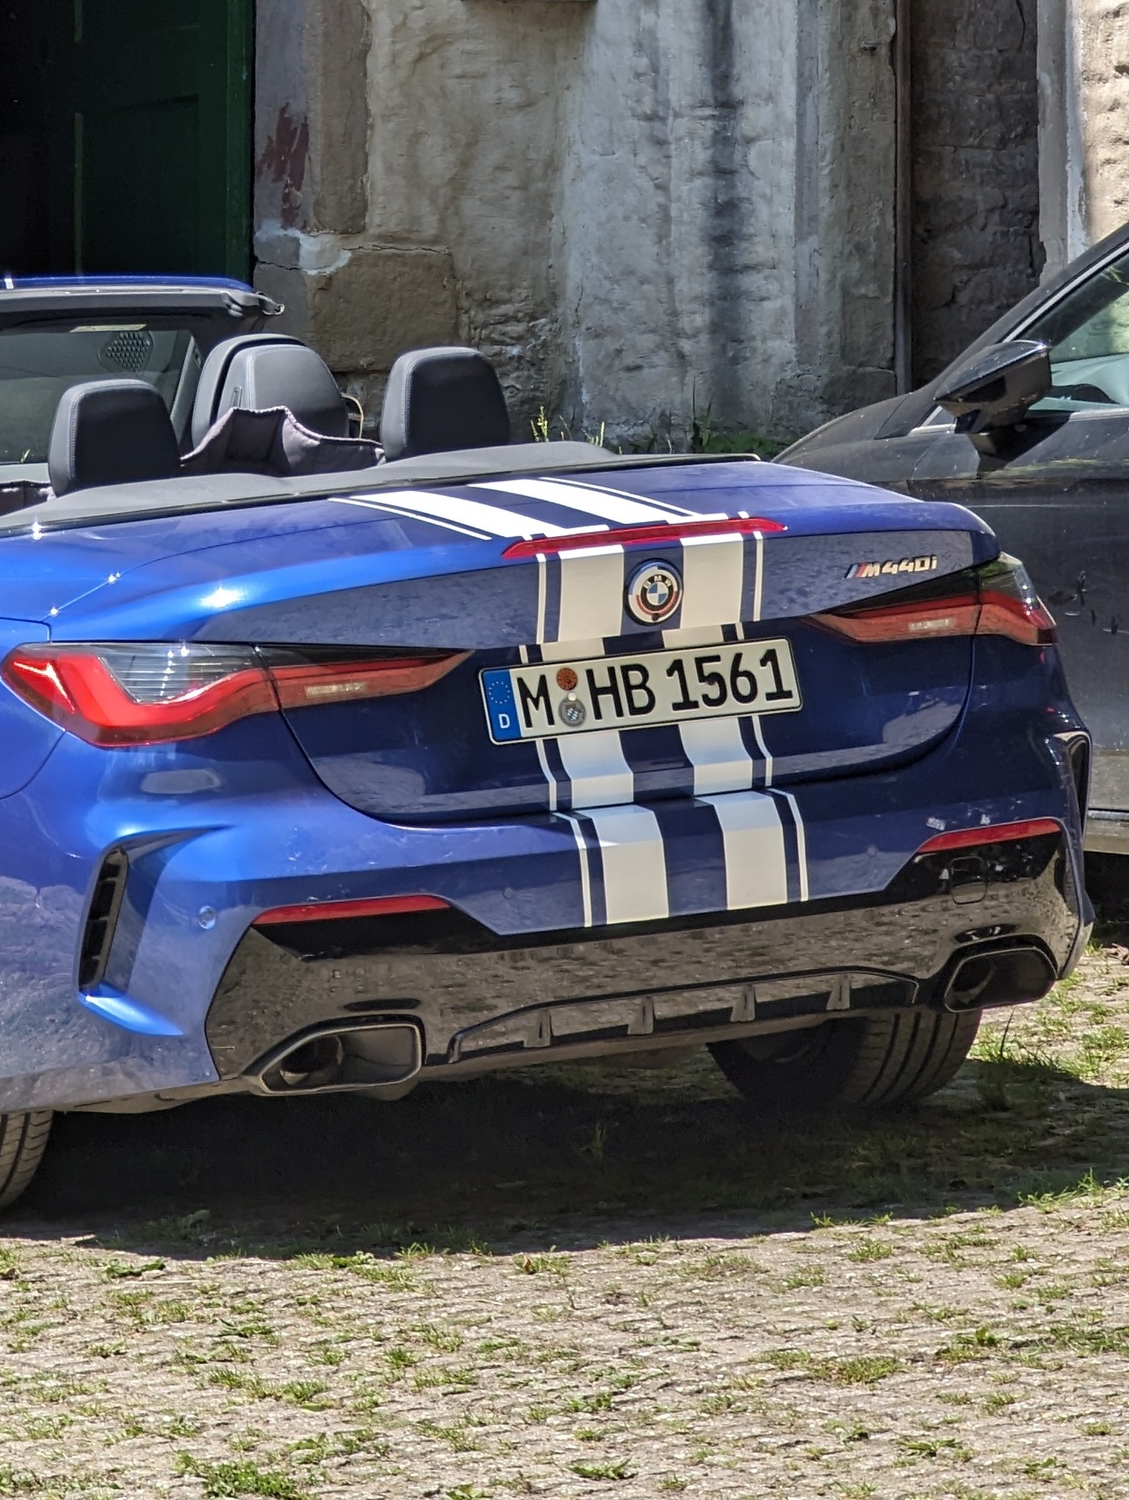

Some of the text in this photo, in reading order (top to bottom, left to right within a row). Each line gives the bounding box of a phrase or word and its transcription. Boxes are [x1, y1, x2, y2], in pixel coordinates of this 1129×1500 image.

[860, 554, 938, 578] M440i
[516, 648, 794, 729] M HB 1561
[498, 713, 511, 729] D
